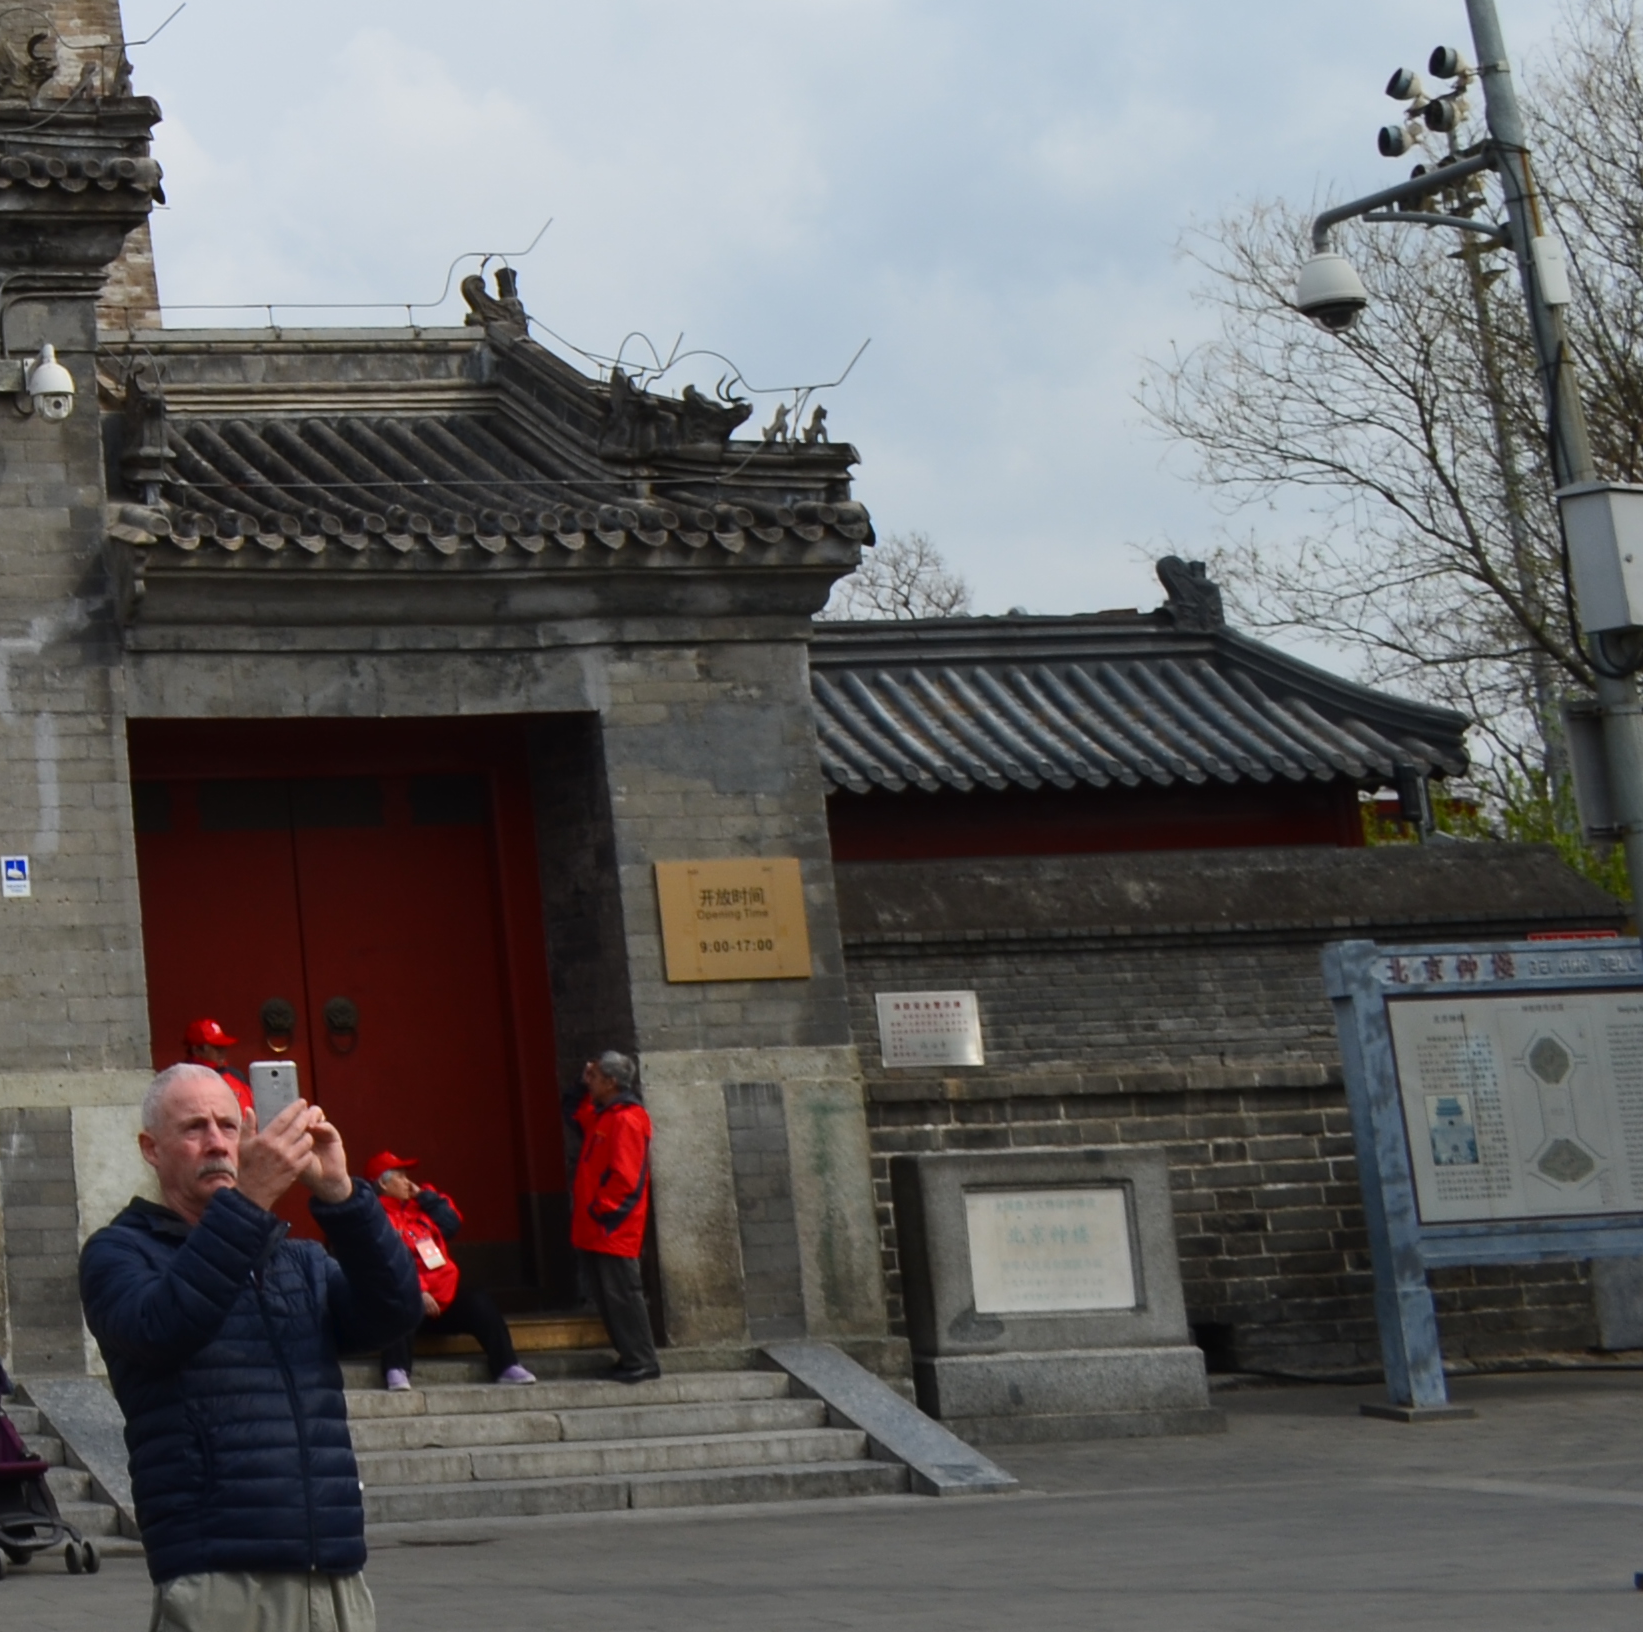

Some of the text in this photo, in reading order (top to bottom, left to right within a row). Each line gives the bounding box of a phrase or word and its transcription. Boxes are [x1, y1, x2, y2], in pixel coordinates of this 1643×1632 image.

[699, 887, 765, 907] 开放时间
[696, 908, 769, 921] Opening Time
[699, 939, 773, 953] 9:00-17:00
[1599, 954, 1637, 972] BELL
